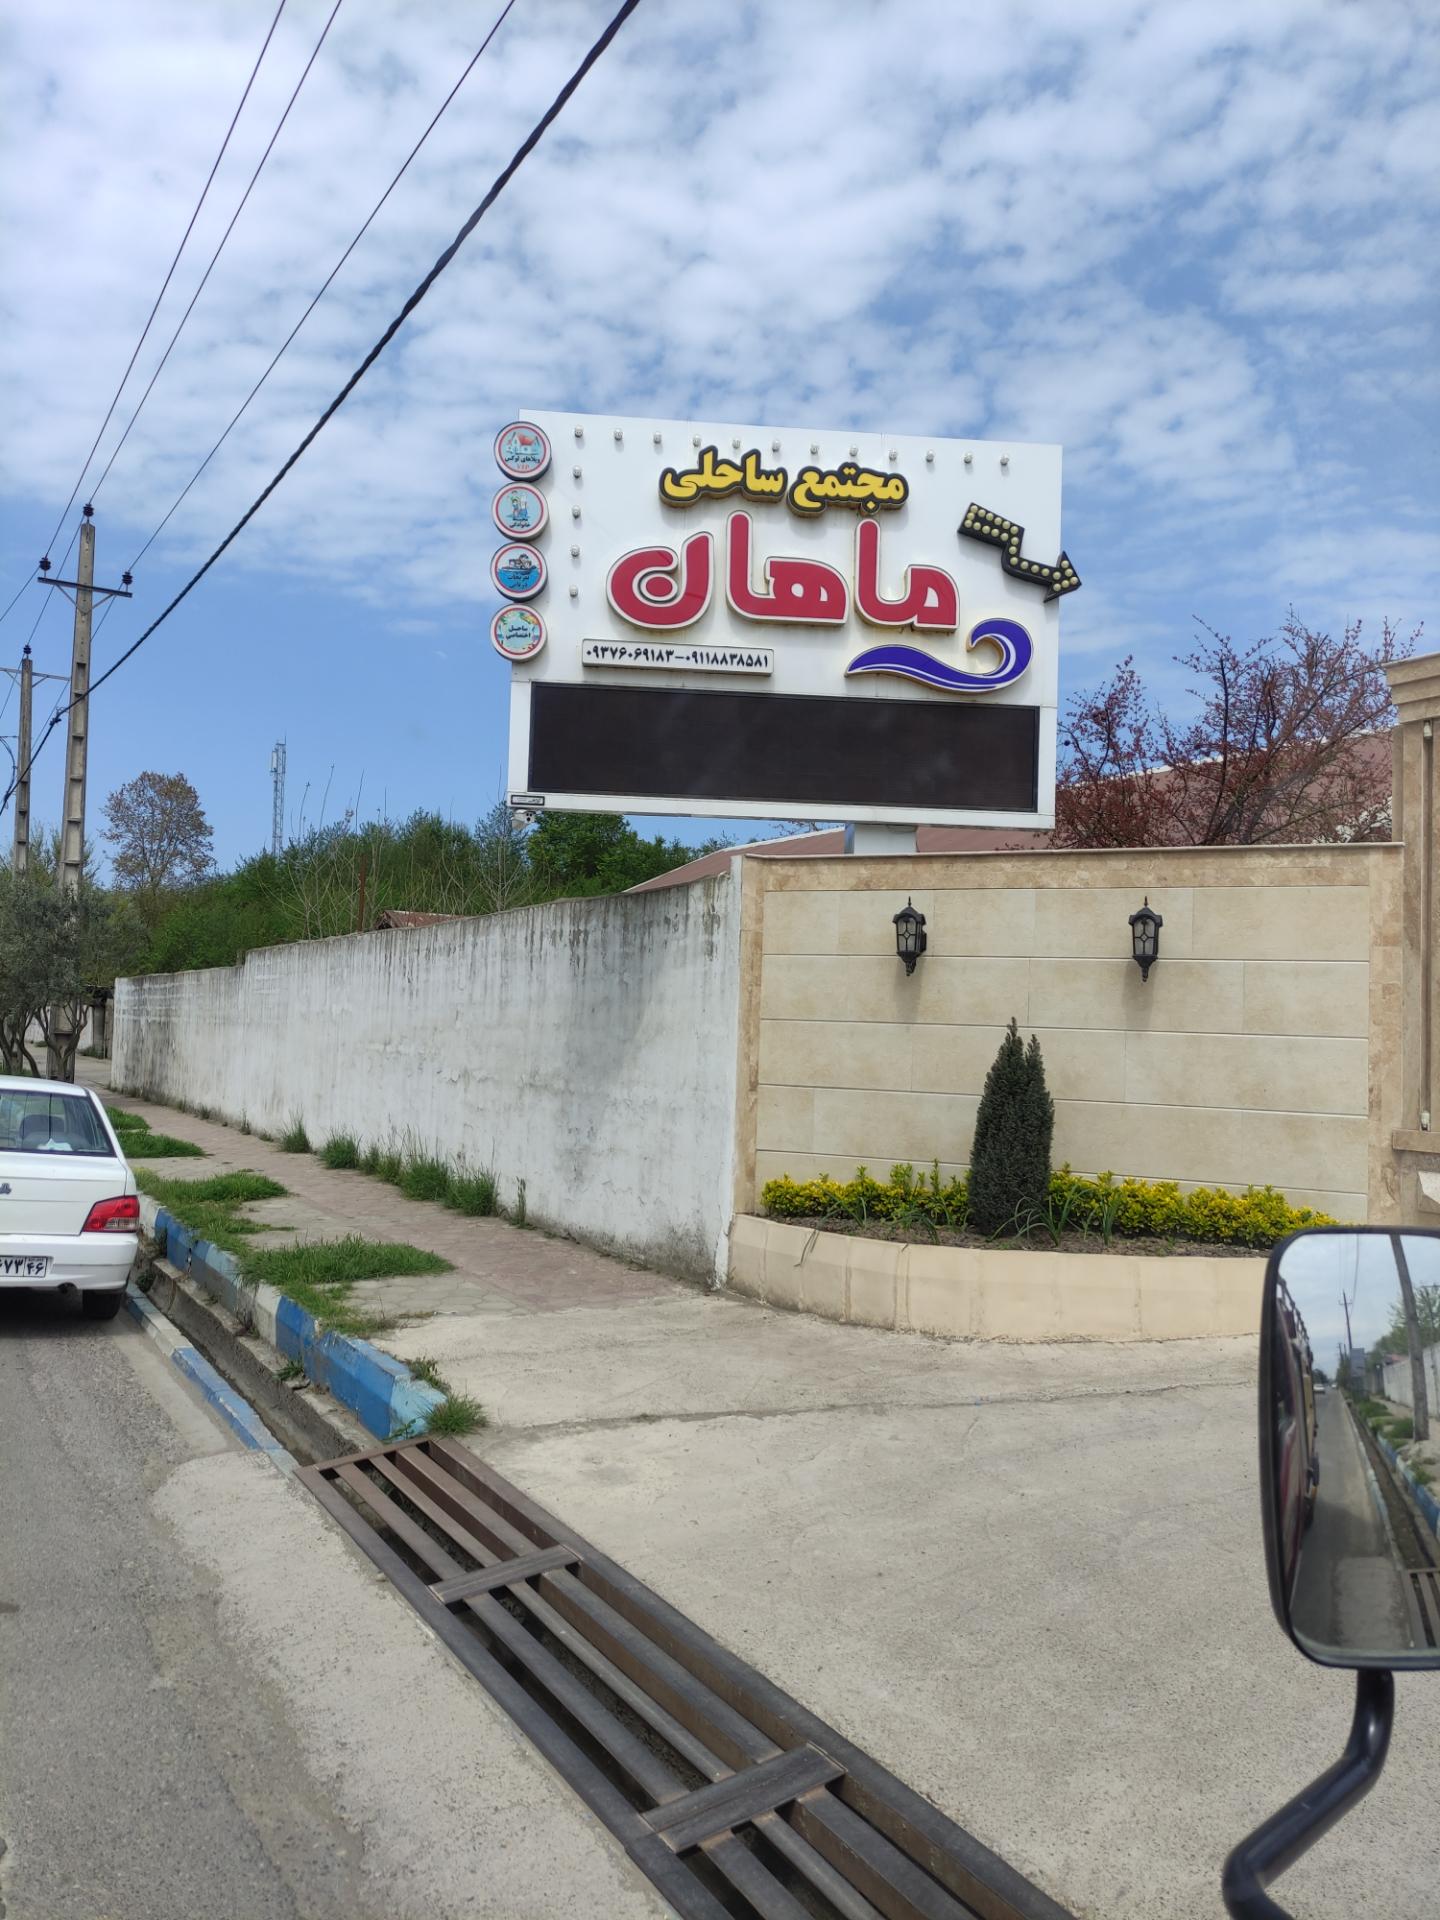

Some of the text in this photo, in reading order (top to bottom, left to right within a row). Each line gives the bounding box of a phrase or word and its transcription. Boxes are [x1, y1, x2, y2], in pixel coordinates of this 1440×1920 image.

[505, 455, 520, 463] لوکس
[664, 451, 905, 512] مجتمع ساحلی
[607, 511, 959, 630] ماهان
